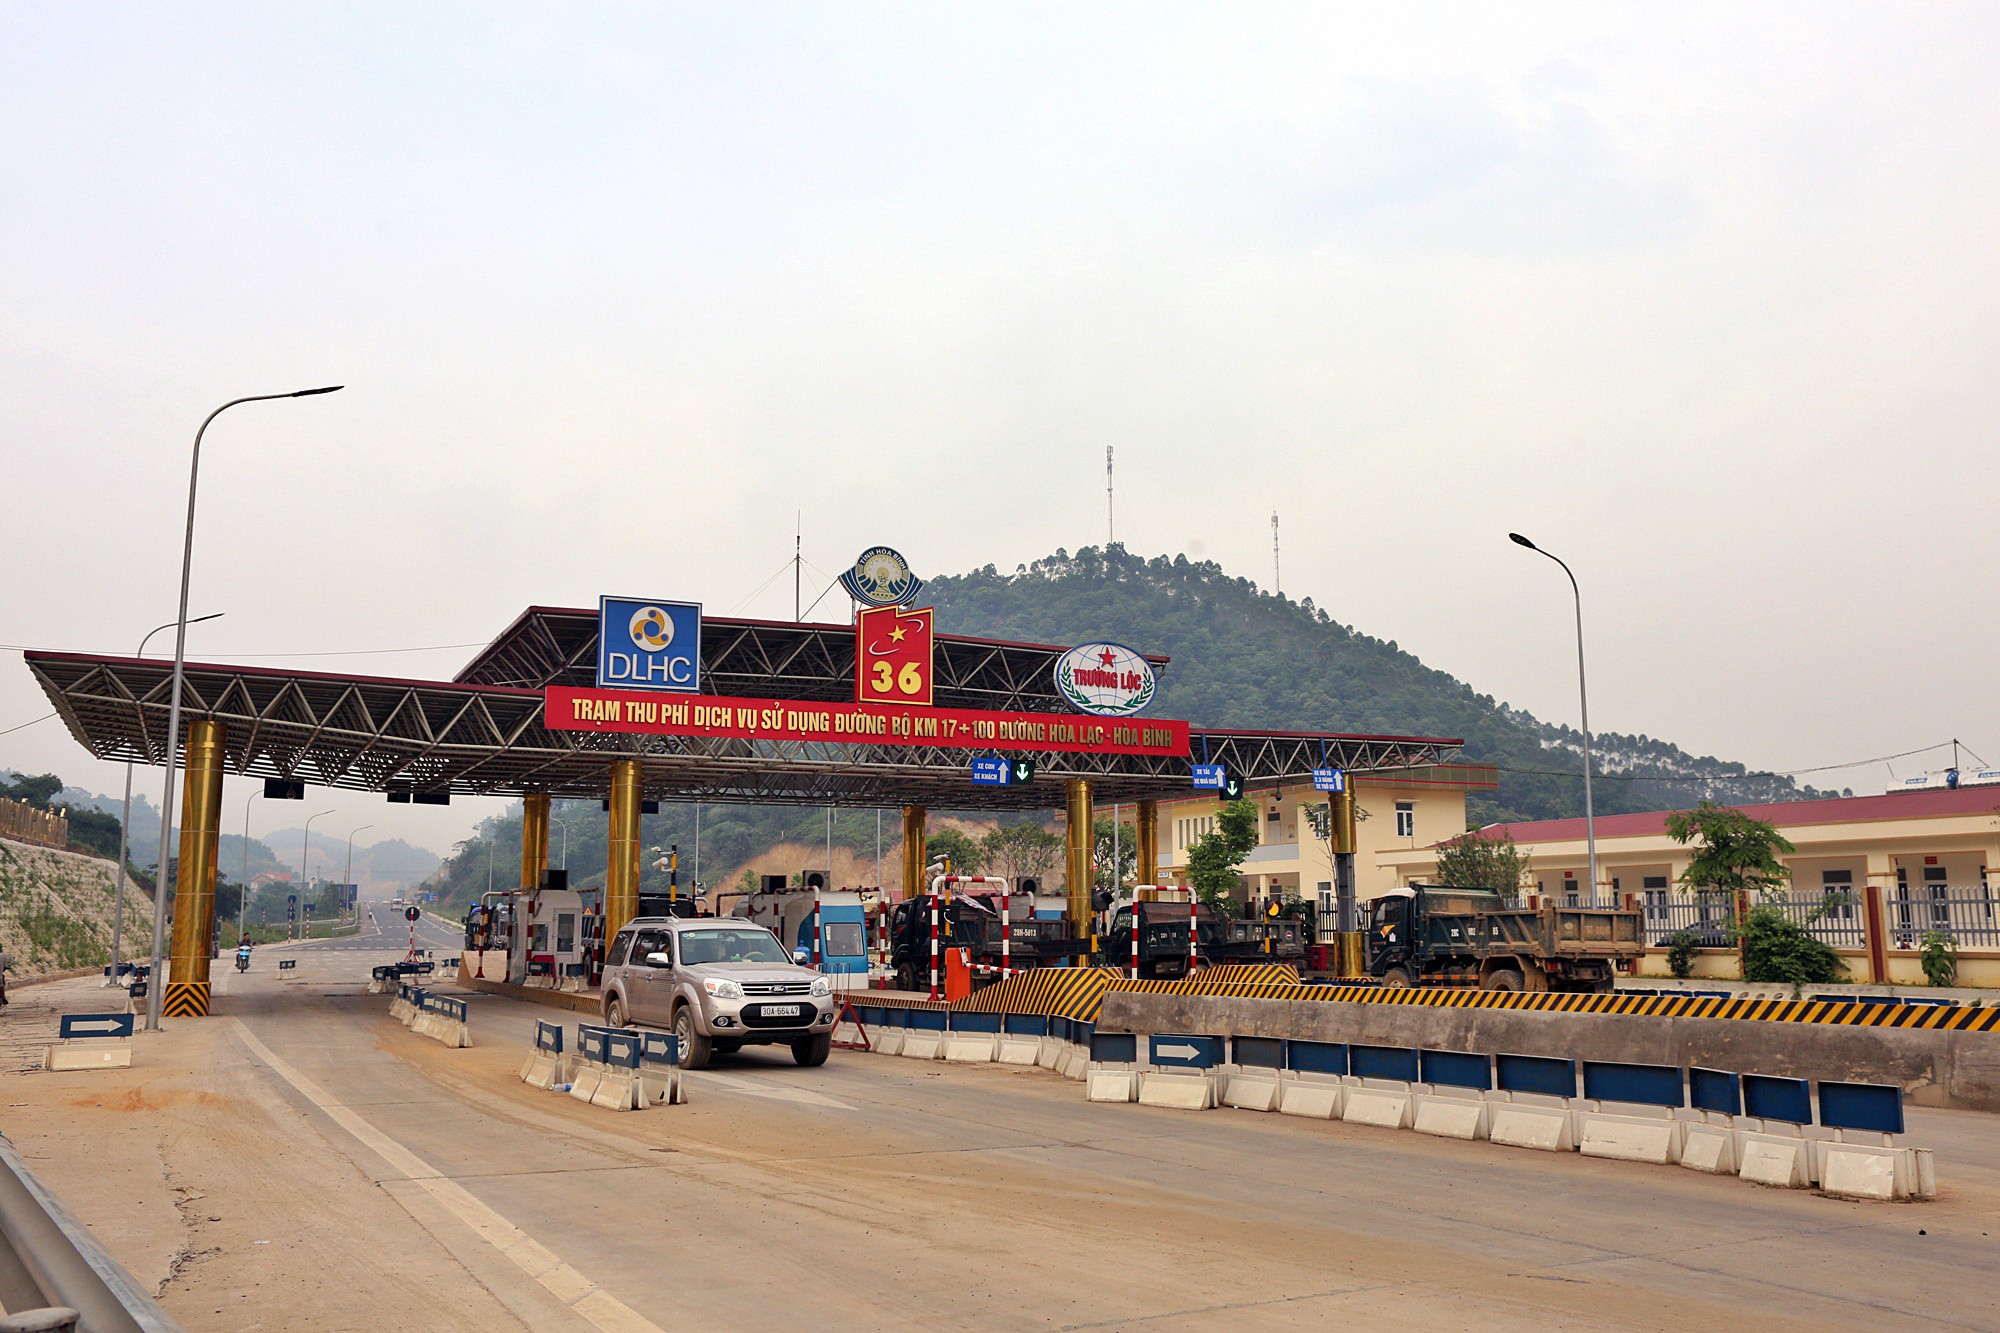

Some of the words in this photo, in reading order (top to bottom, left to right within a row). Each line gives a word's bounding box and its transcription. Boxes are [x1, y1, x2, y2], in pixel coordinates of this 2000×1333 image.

[876, 548, 892, 556] HÒA
[608, 652, 691, 683] DLHC
[870, 660, 922, 695] 36
[1073, 666, 1118, 689] TRƯỜNG
[1120, 670, 1142, 694] LỘC
[571, 698, 621, 726] TRẠM
[625, 701, 657, 724] THU
[660, 700, 690, 726] PHÍ
[693, 705, 732, 731] DỊCH
[736, 708, 758, 734] VỤ
[760, 702, 784, 730] SỬ
[787, 710, 830, 736] DỤNG
[834, 708, 887, 735] ĐƯỜNG
[891, 712, 911, 740] BỘ
[914, 717, 938, 737] KM
[998, 717, 1045, 742] ĐƯỜNG
[1049, 719, 1076, 743] HÒA
[1079, 725, 1104, 748] LẠC
[1113, 722, 1140, 746] HÒA
[1142, 724, 1173, 748] BÌNH
[981, 772, 998, 780] KHÁCH
